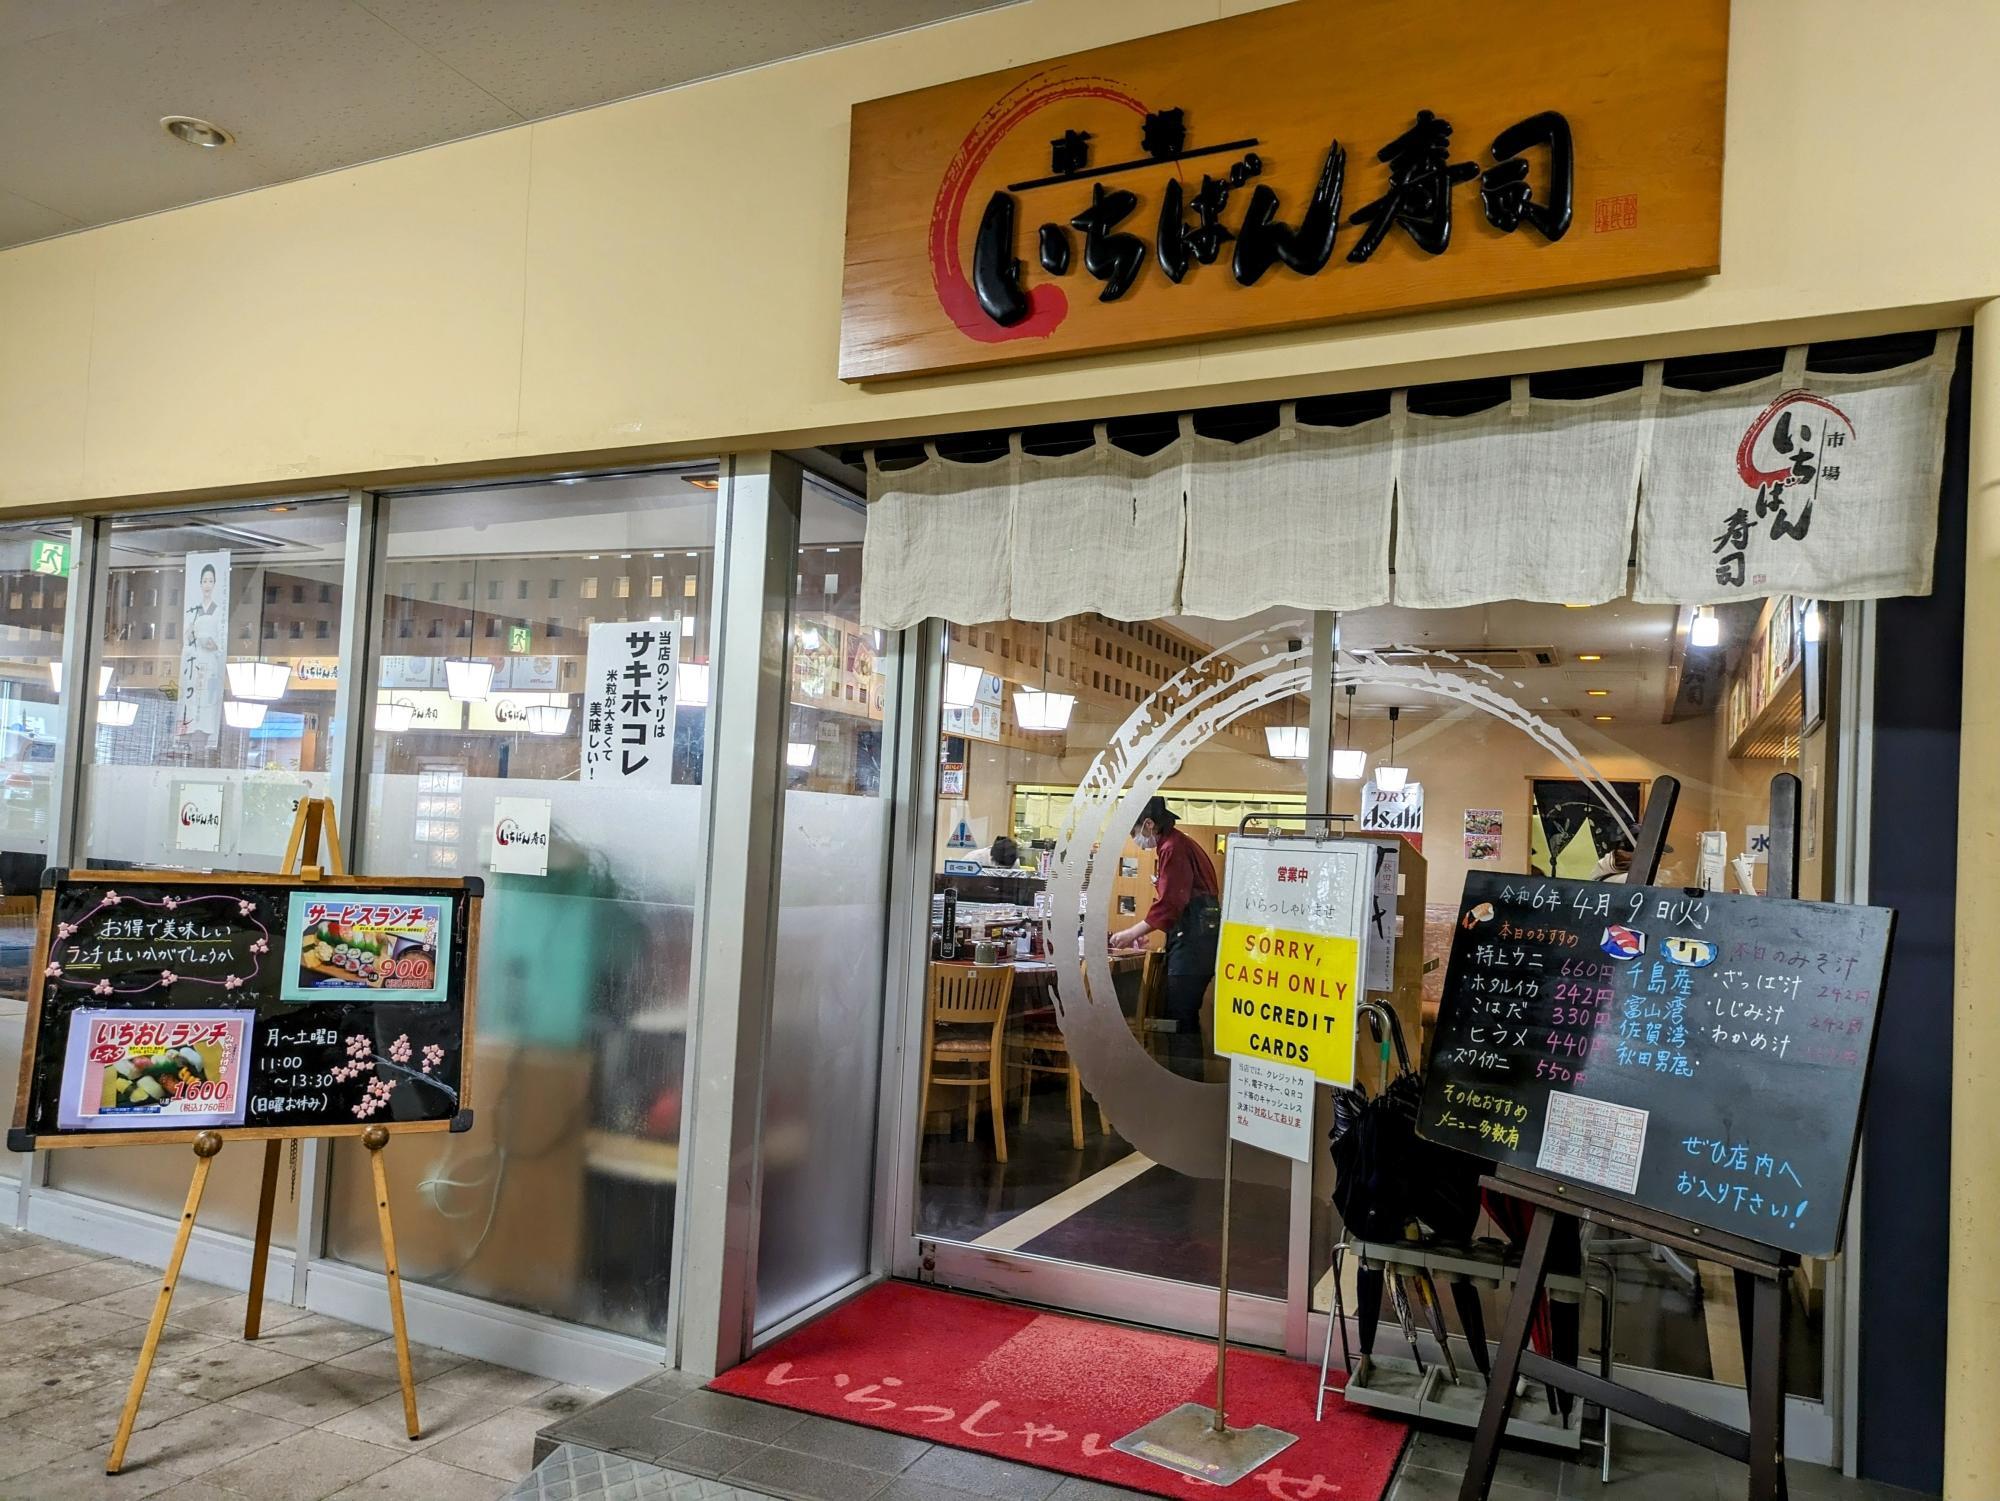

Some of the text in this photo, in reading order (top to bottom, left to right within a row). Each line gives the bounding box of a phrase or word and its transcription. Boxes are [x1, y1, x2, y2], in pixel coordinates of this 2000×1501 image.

[1821, 431, 1846, 481] 市場
[653, 630, 672, 739] 当店のシャリは
[602, 669, 618, 762] 米粒が大きくて
[620, 631, 656, 776] サキホコレ
[586, 701, 602, 780] 美味しい！
[1363, 804, 1422, 830] Asahi
[1277, 866, 1308, 884] 営業中
[100, 918, 231, 939] お得で美味しい
[308, 903, 424, 928] サービスランチ
[1245, 935, 1321, 967] SORRY,
[1498, 921, 1579, 949] 本日のおすすめ
[66, 946, 234, 964] ランチはいかがでしょうか
[1224, 963, 1347, 1001] CASH ONLY
[1232, 997, 1335, 1034] NO CREDIT
[96, 1021, 229, 1047] いちおしランチ
[1250, 1033, 1310, 1063] CARDS
[261, 1056, 302, 1071] 11:00
[1443, 1084, 1528, 1123] その他おすすめ
[1434, 1110, 1520, 1152] メニュー多数有
[1681, 1136, 1803, 1188] ぜひ店内へ
